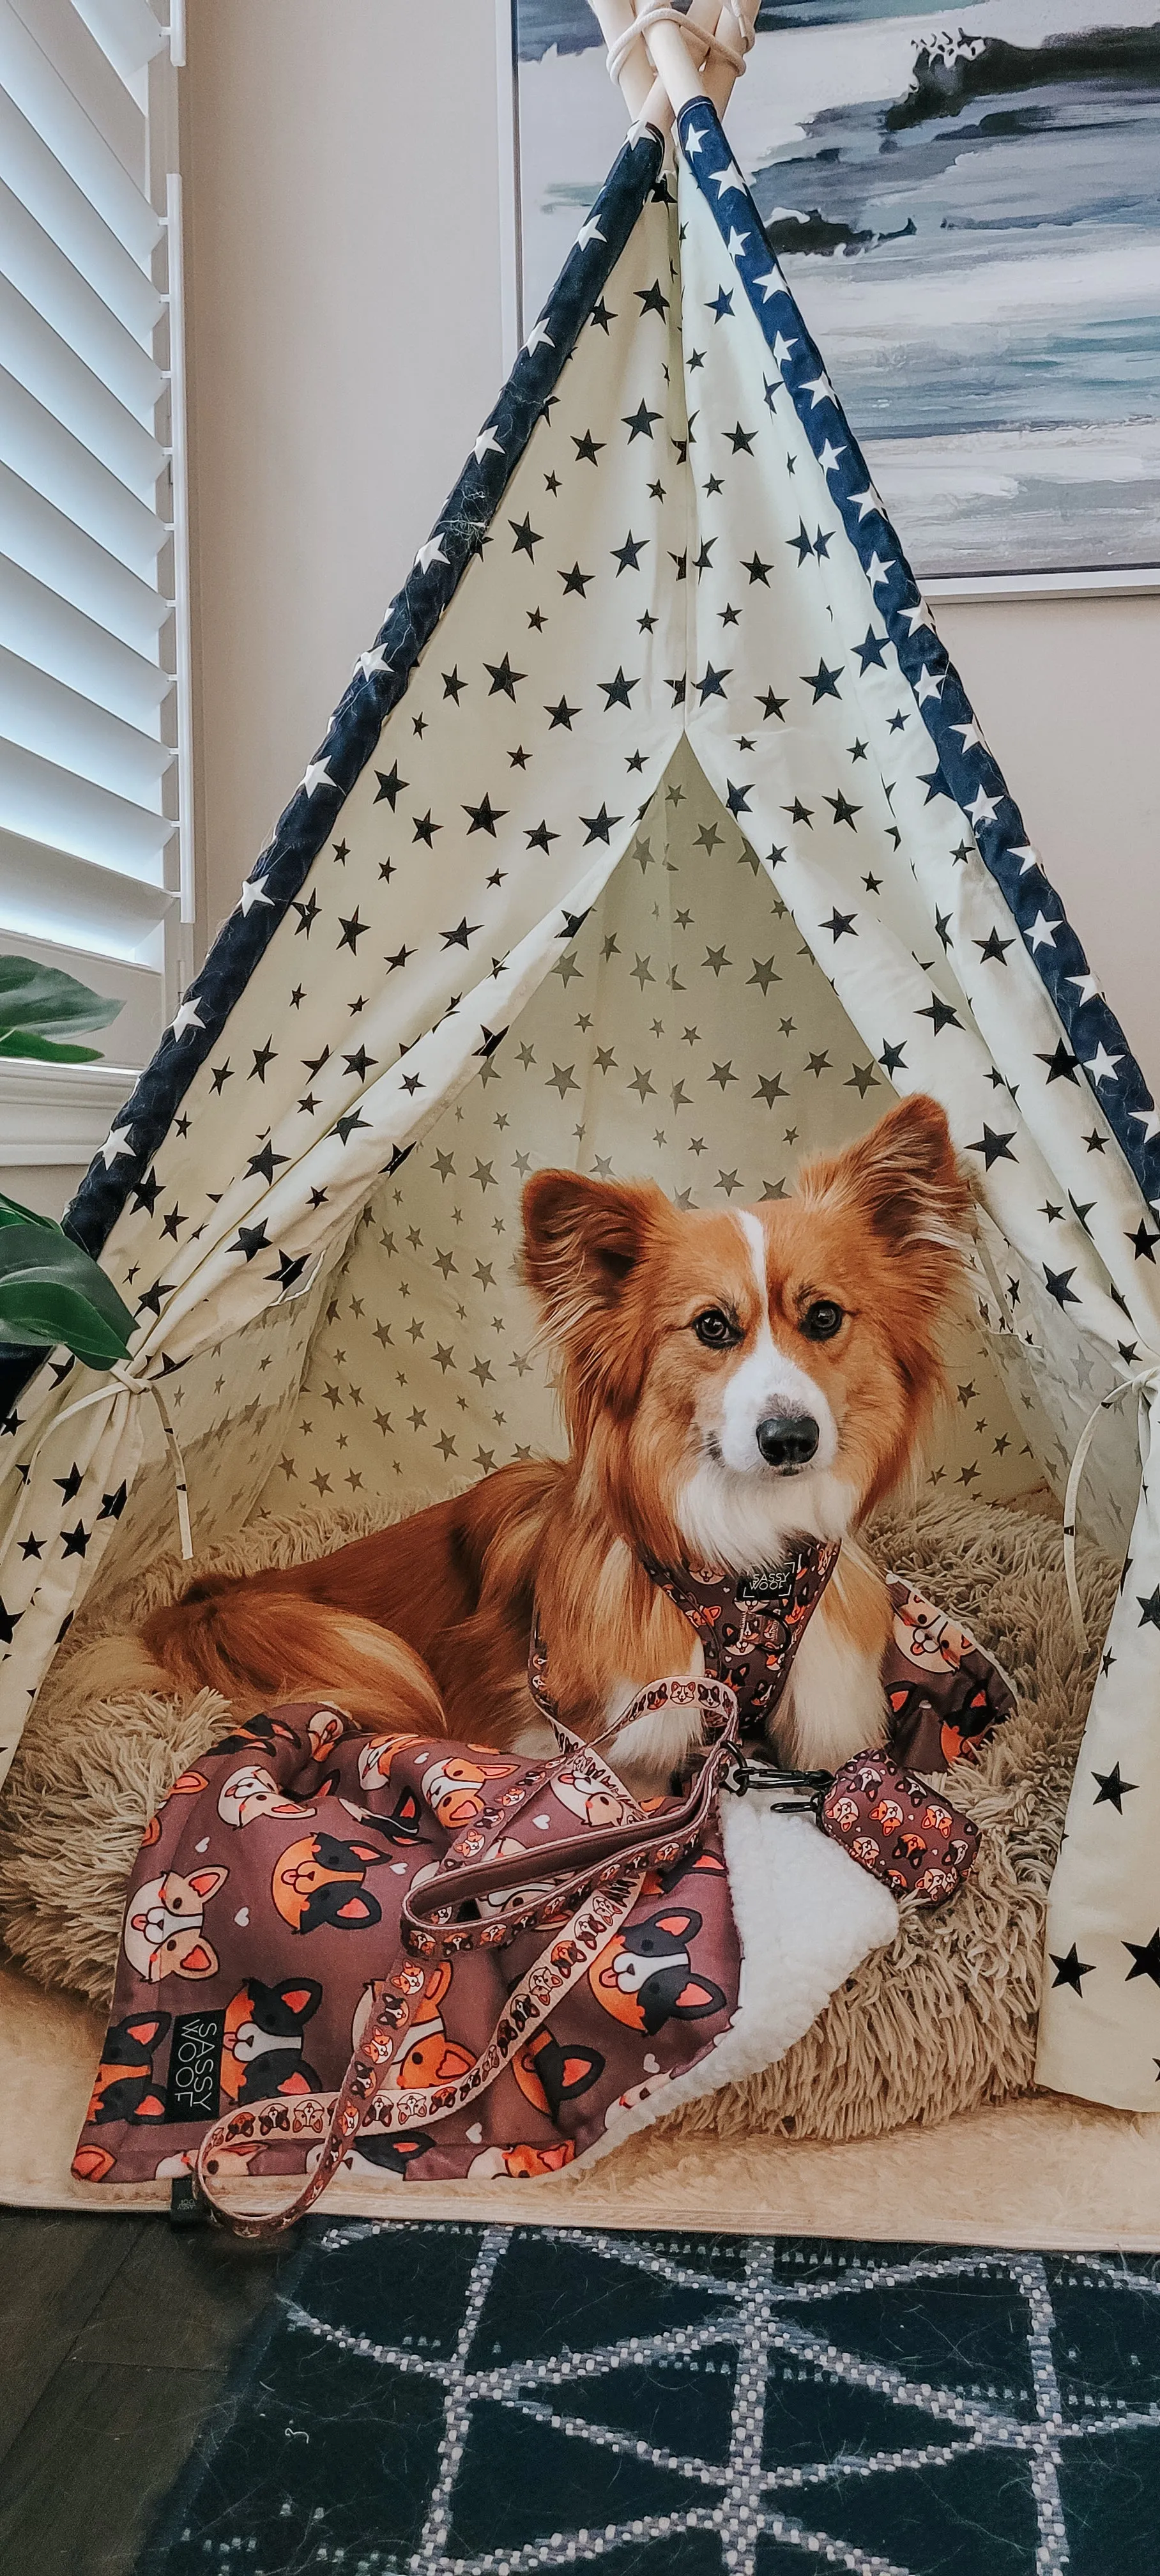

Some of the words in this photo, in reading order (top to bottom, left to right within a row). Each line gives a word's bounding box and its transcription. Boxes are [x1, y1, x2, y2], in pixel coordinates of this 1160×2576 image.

[749, 1580, 786, 1590] WOOF
[752, 1572, 790, 1583] SASSY
[174, 2019, 200, 2107] WOOF
[193, 2023, 217, 2111] SASSY
